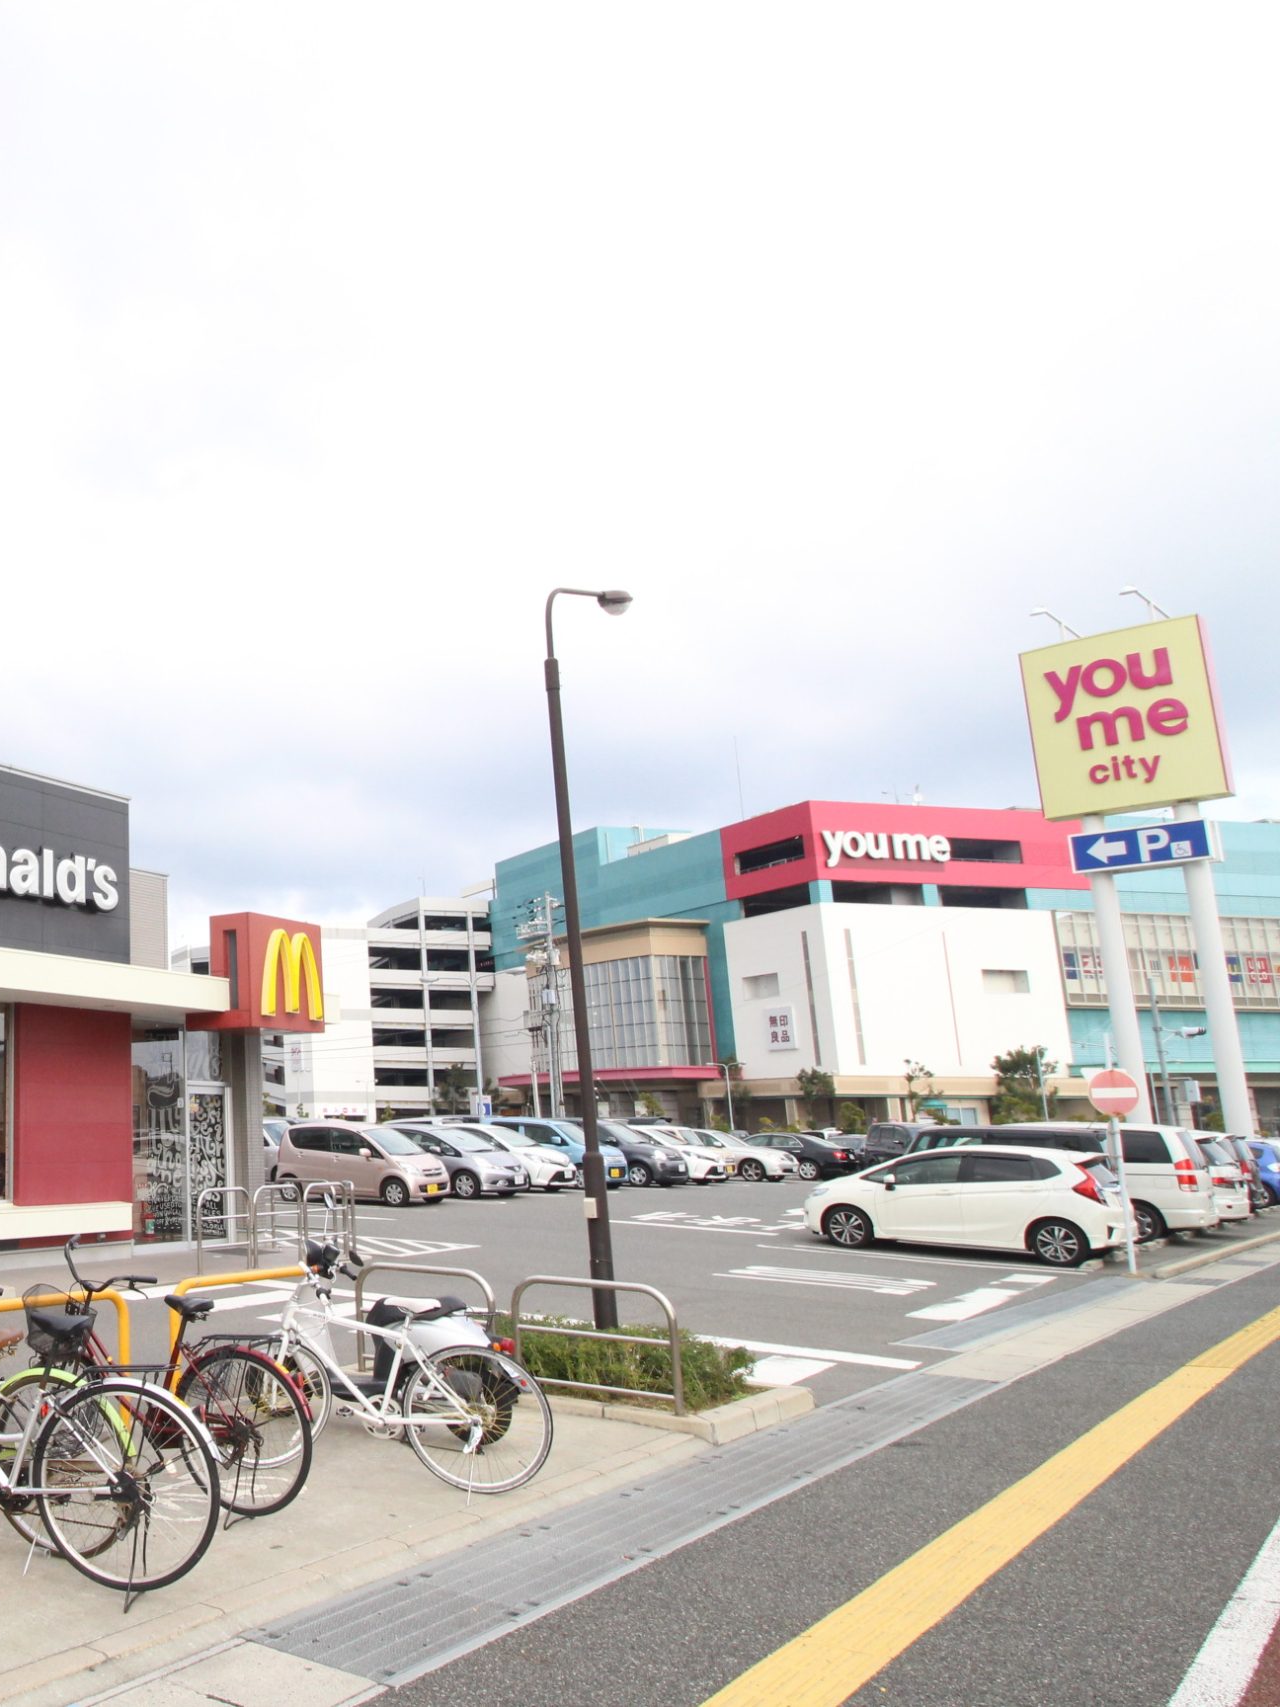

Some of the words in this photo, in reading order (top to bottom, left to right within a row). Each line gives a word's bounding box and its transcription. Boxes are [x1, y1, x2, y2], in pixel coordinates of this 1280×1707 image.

[1043, 647, 1173, 724] you
[1075, 698, 1189, 751] me
[1088, 754, 1161, 784] city
[1136, 828, 1169, 863] P
